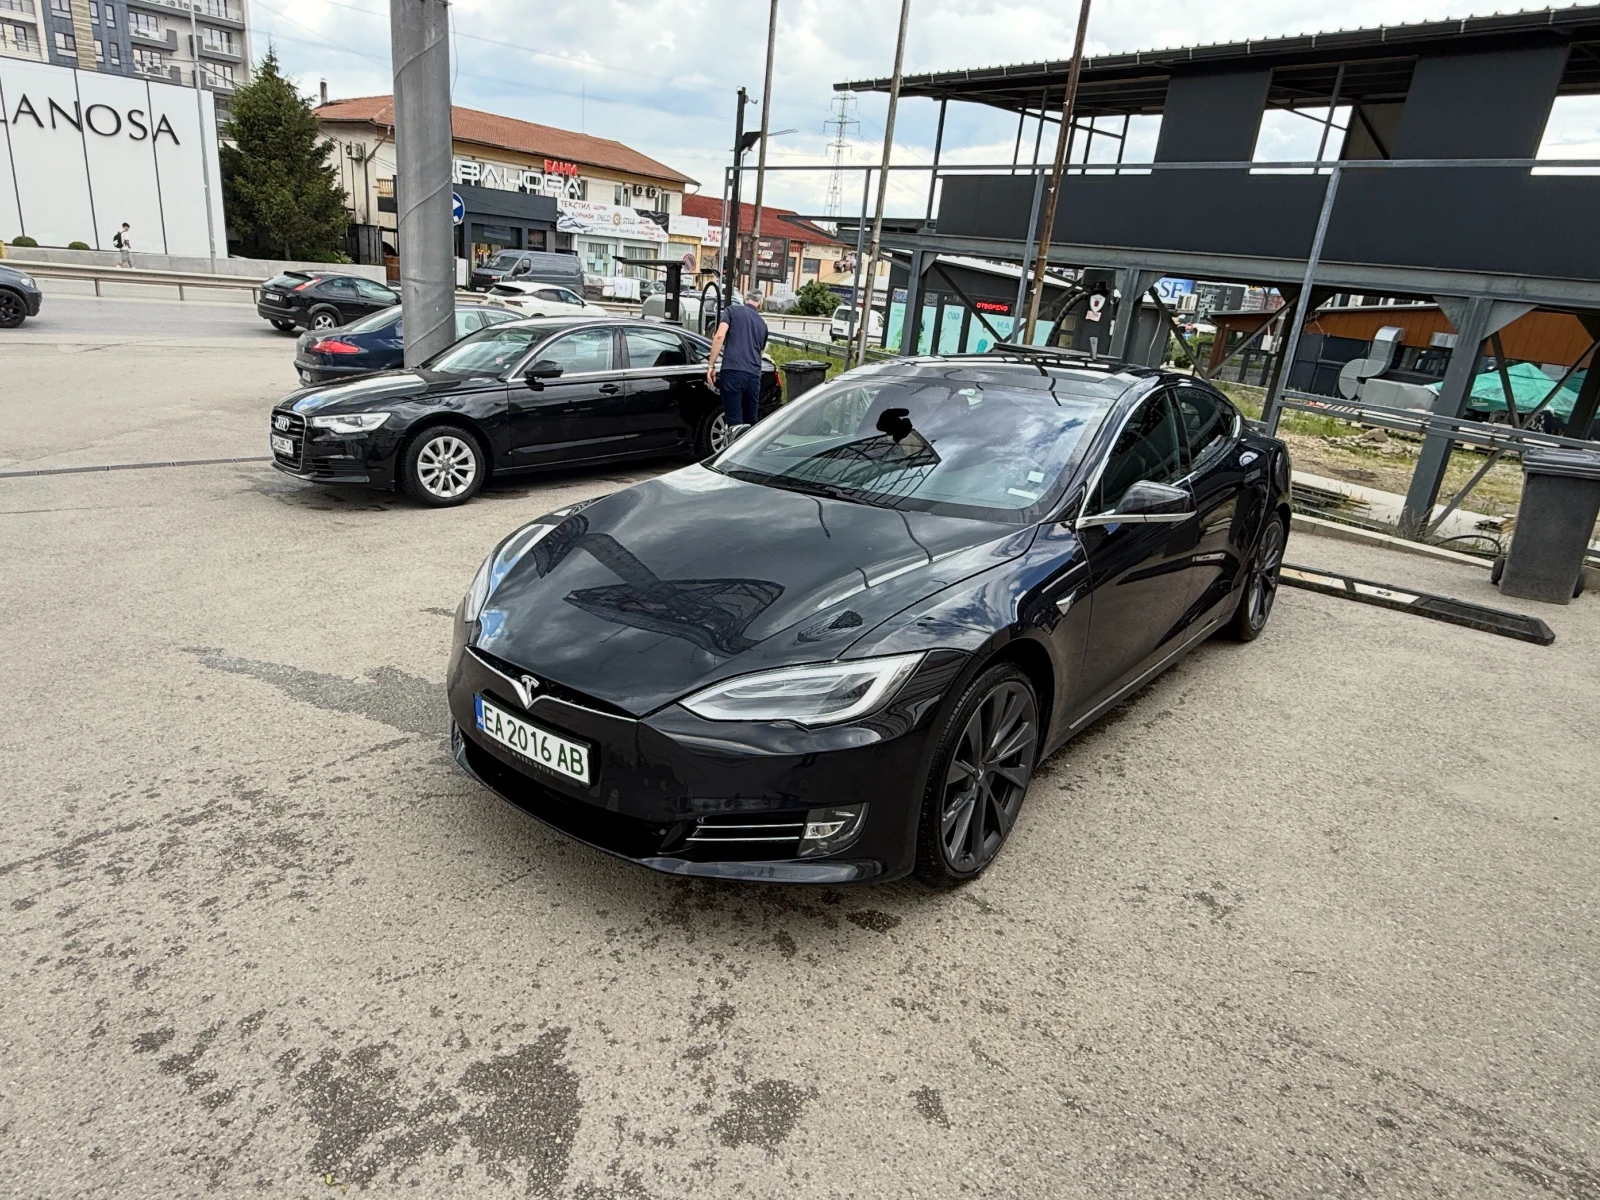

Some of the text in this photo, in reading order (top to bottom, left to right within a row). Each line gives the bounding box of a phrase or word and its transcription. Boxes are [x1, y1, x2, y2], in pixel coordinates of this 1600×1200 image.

[0, 93, 180, 146] ANOSA
[544, 159, 578, 176] БАНИ
[560, 200, 591, 211] ТЕКСТИЛ
